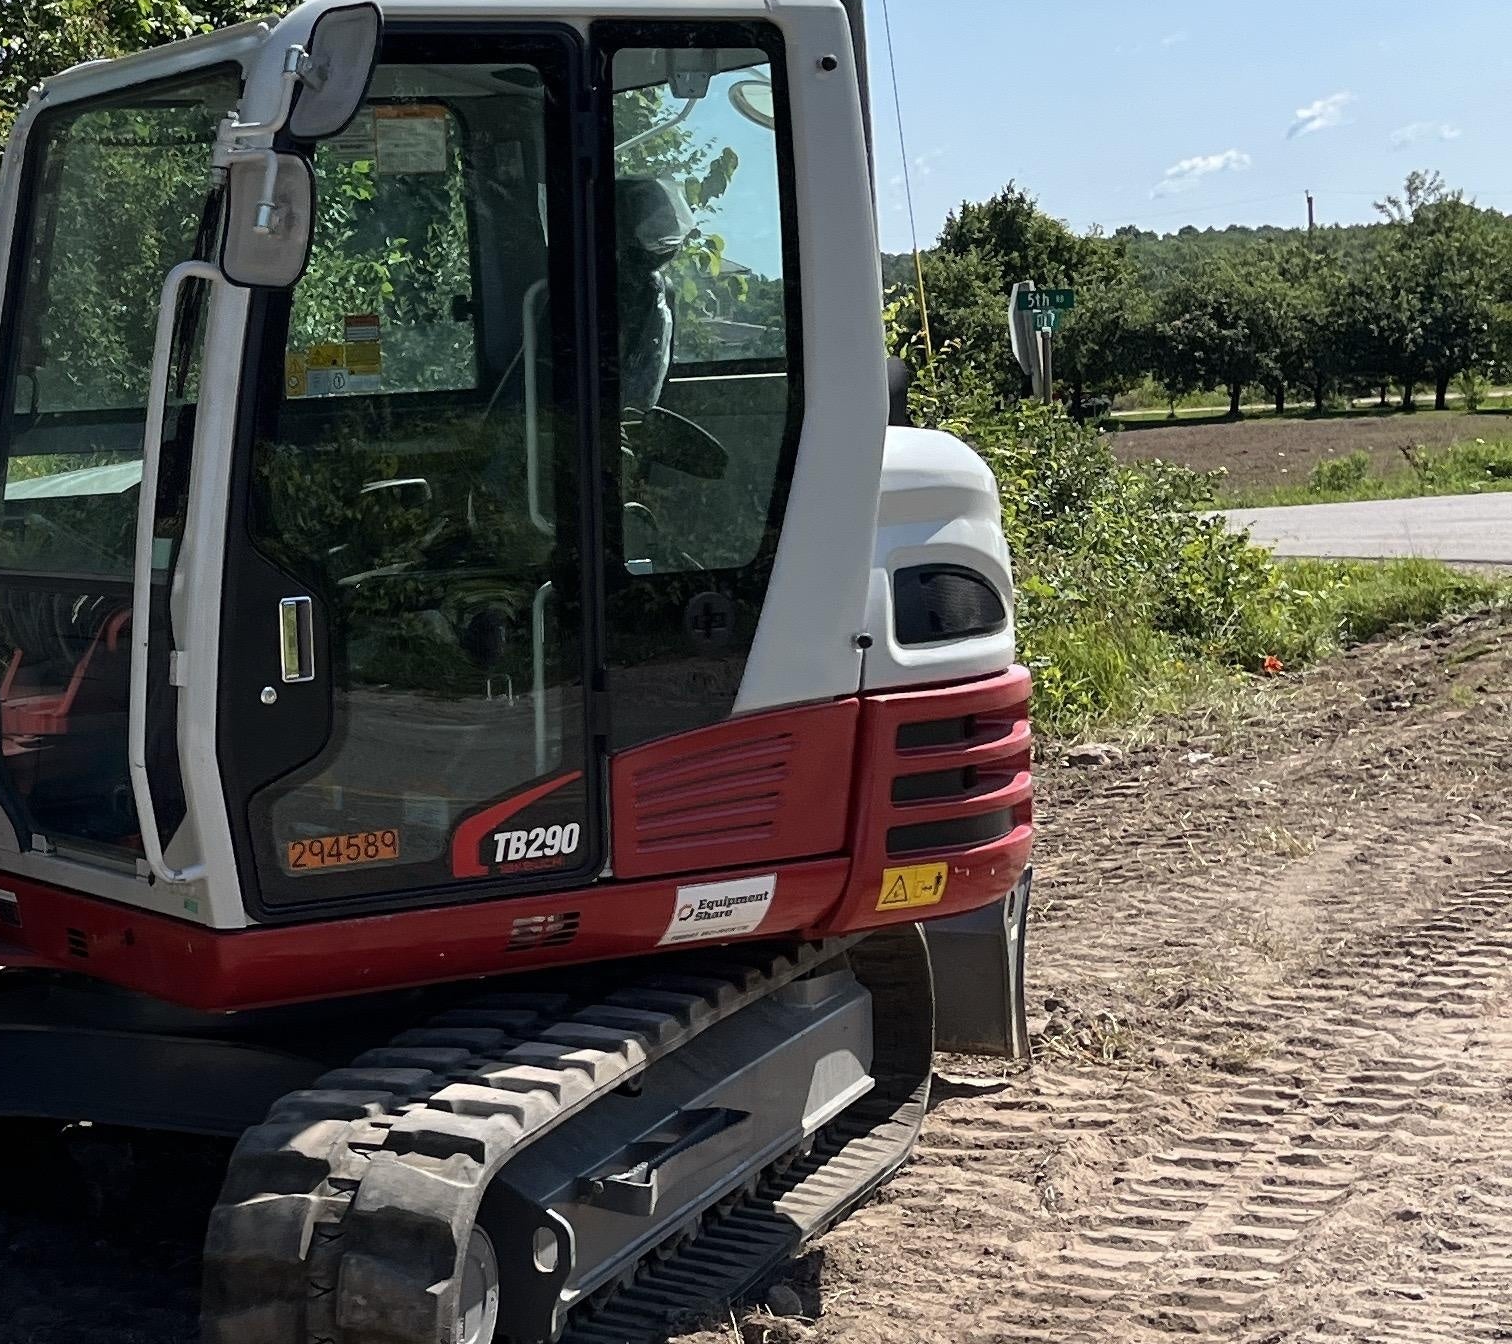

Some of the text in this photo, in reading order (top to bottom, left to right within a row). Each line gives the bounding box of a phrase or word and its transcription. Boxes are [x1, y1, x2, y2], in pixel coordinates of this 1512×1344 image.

[1027, 292, 1050, 308] 5th
[291, 830, 397, 868] 294589
[493, 822, 581, 863] TB290
[697, 890, 769, 911] Equipment
[693, 909, 733, 922] Share
